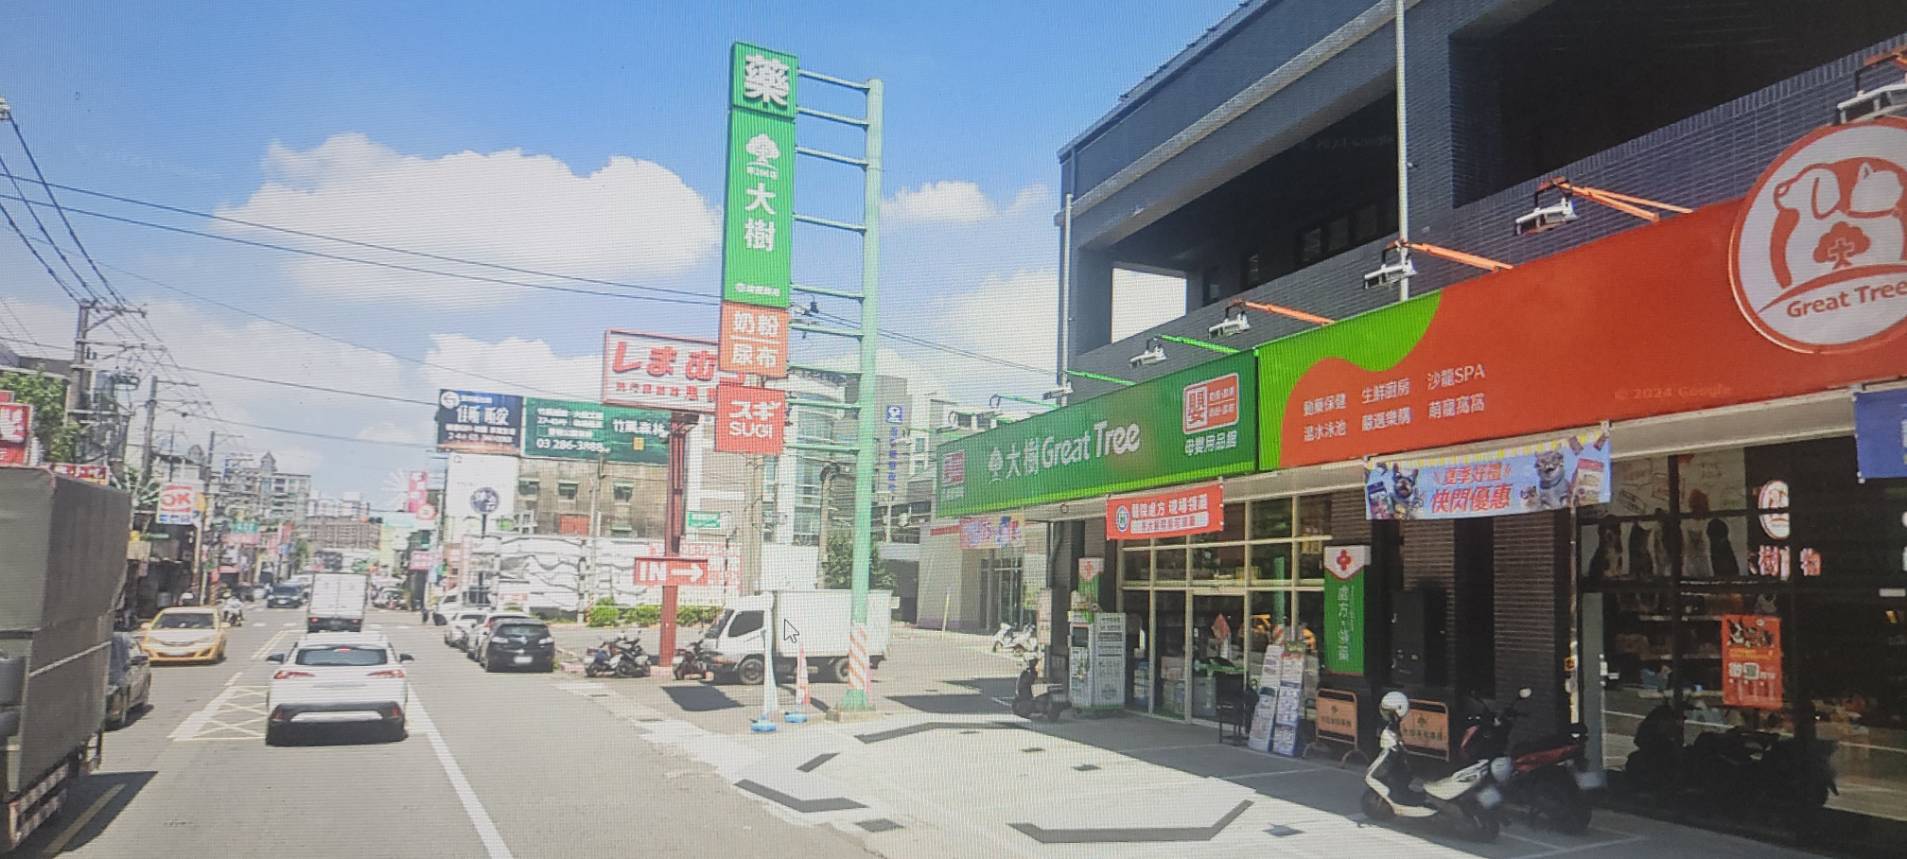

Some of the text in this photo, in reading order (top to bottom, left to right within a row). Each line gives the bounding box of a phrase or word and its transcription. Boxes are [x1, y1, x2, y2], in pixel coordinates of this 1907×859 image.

[743, 53, 790, 106] 藥
[744, 182, 777, 252] 大樹
[1786, 281, 1907, 318] Great Tree
[735, 310, 780, 337] 奶粉
[612, 341, 746, 384] しまむ
[732, 343, 778, 369] 尿布
[1361, 378, 1411, 404] 生鮮廚房
[1427, 363, 1486, 391] 沙龍SPA
[729, 399, 781, 421] スギ
[729, 420, 774, 438] SUGI
[1006, 437, 1039, 479] 大樹
[1041, 431, 1091, 469] Great
[1093, 420, 1141, 458] Tree
[162, 494, 191, 507] OK
[1431, 483, 1513, 513] 快閃優惠
[639, 560, 667, 581] IN
